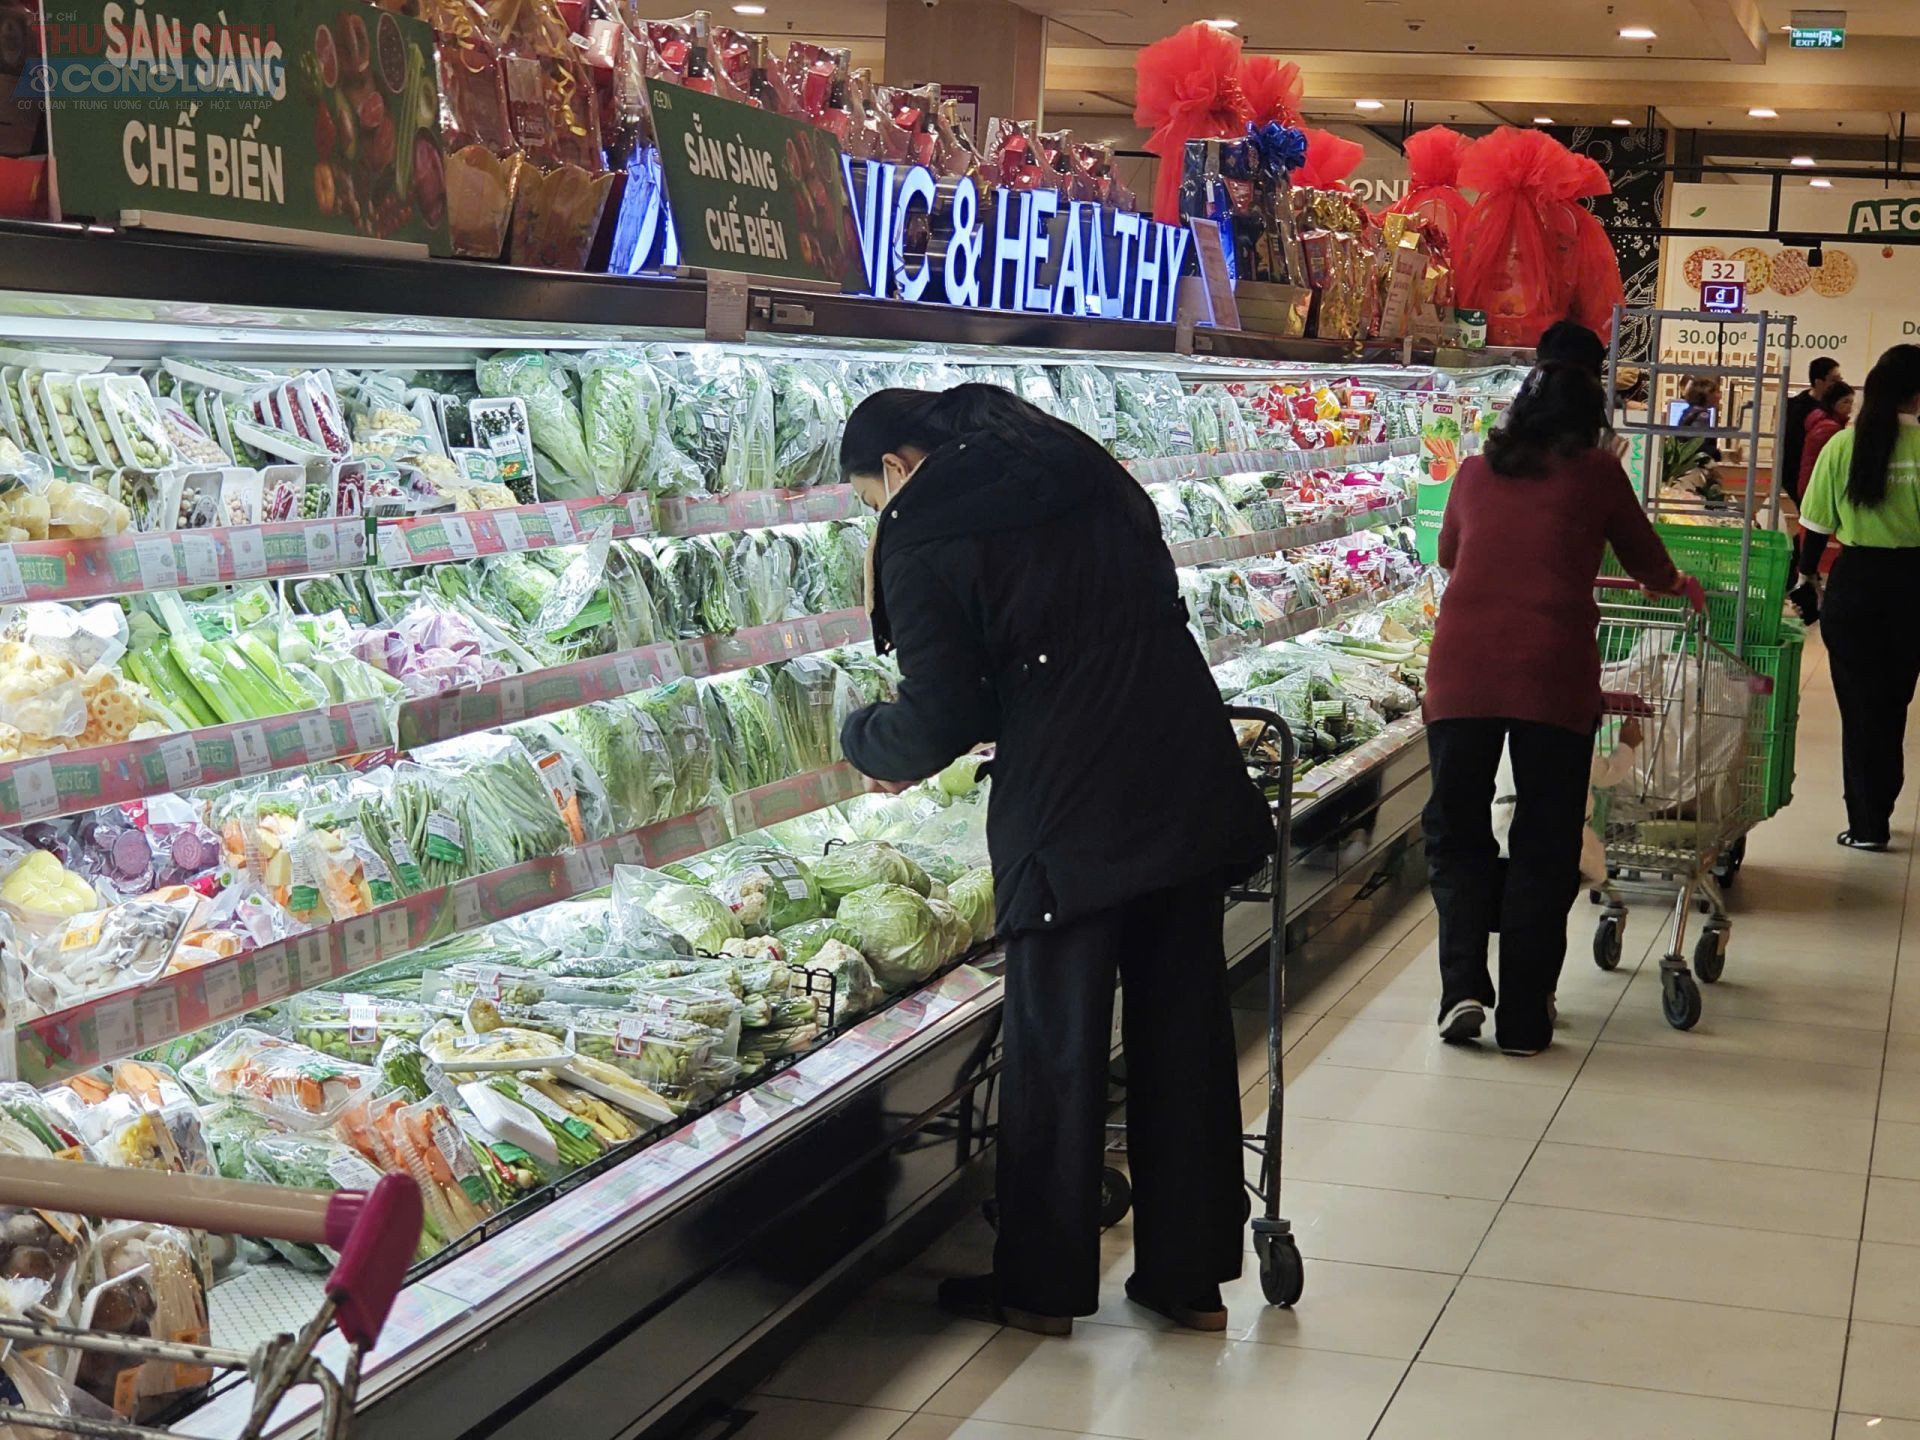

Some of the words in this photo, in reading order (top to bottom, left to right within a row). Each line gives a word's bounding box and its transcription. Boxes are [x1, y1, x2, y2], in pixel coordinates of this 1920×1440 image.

[193, 10, 286, 100] SÀNG
[122, 102, 198, 192] CHẾ
[206, 114, 285, 204] BIẾN
[684, 112, 728, 181] SẴN
[726, 133, 778, 191] SÀNG
[705, 195, 745, 254] CHẾ
[744, 201, 788, 260] BIẾN
[945, 175, 983, 307] &
[991, 187, 1190, 322] HEALTHY
[1711, 263, 1735, 279] 32
